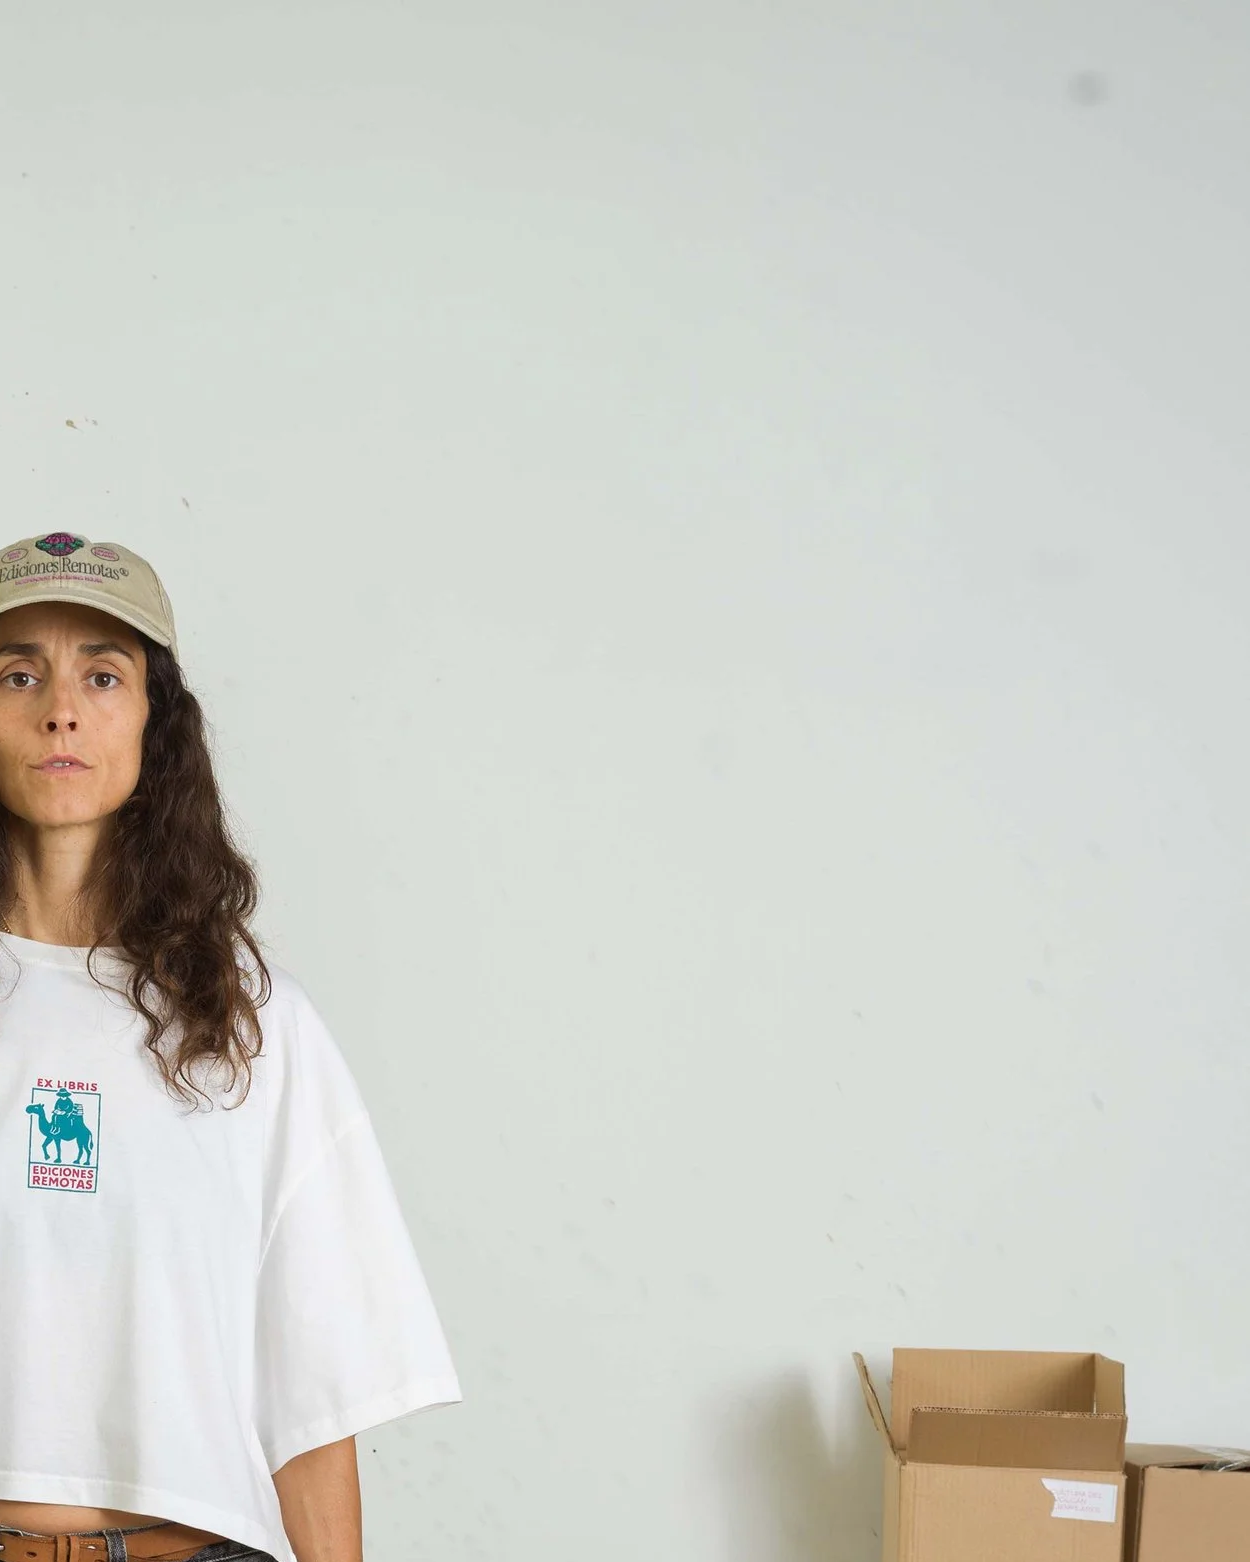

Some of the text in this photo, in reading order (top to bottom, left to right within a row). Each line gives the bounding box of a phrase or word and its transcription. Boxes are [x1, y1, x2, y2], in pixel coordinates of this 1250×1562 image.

[37, 1078, 98, 1092] EX LIBRIS
[32, 1165, 94, 1179] EDICIONES
[32, 1175, 93, 1190] REMOTAS
